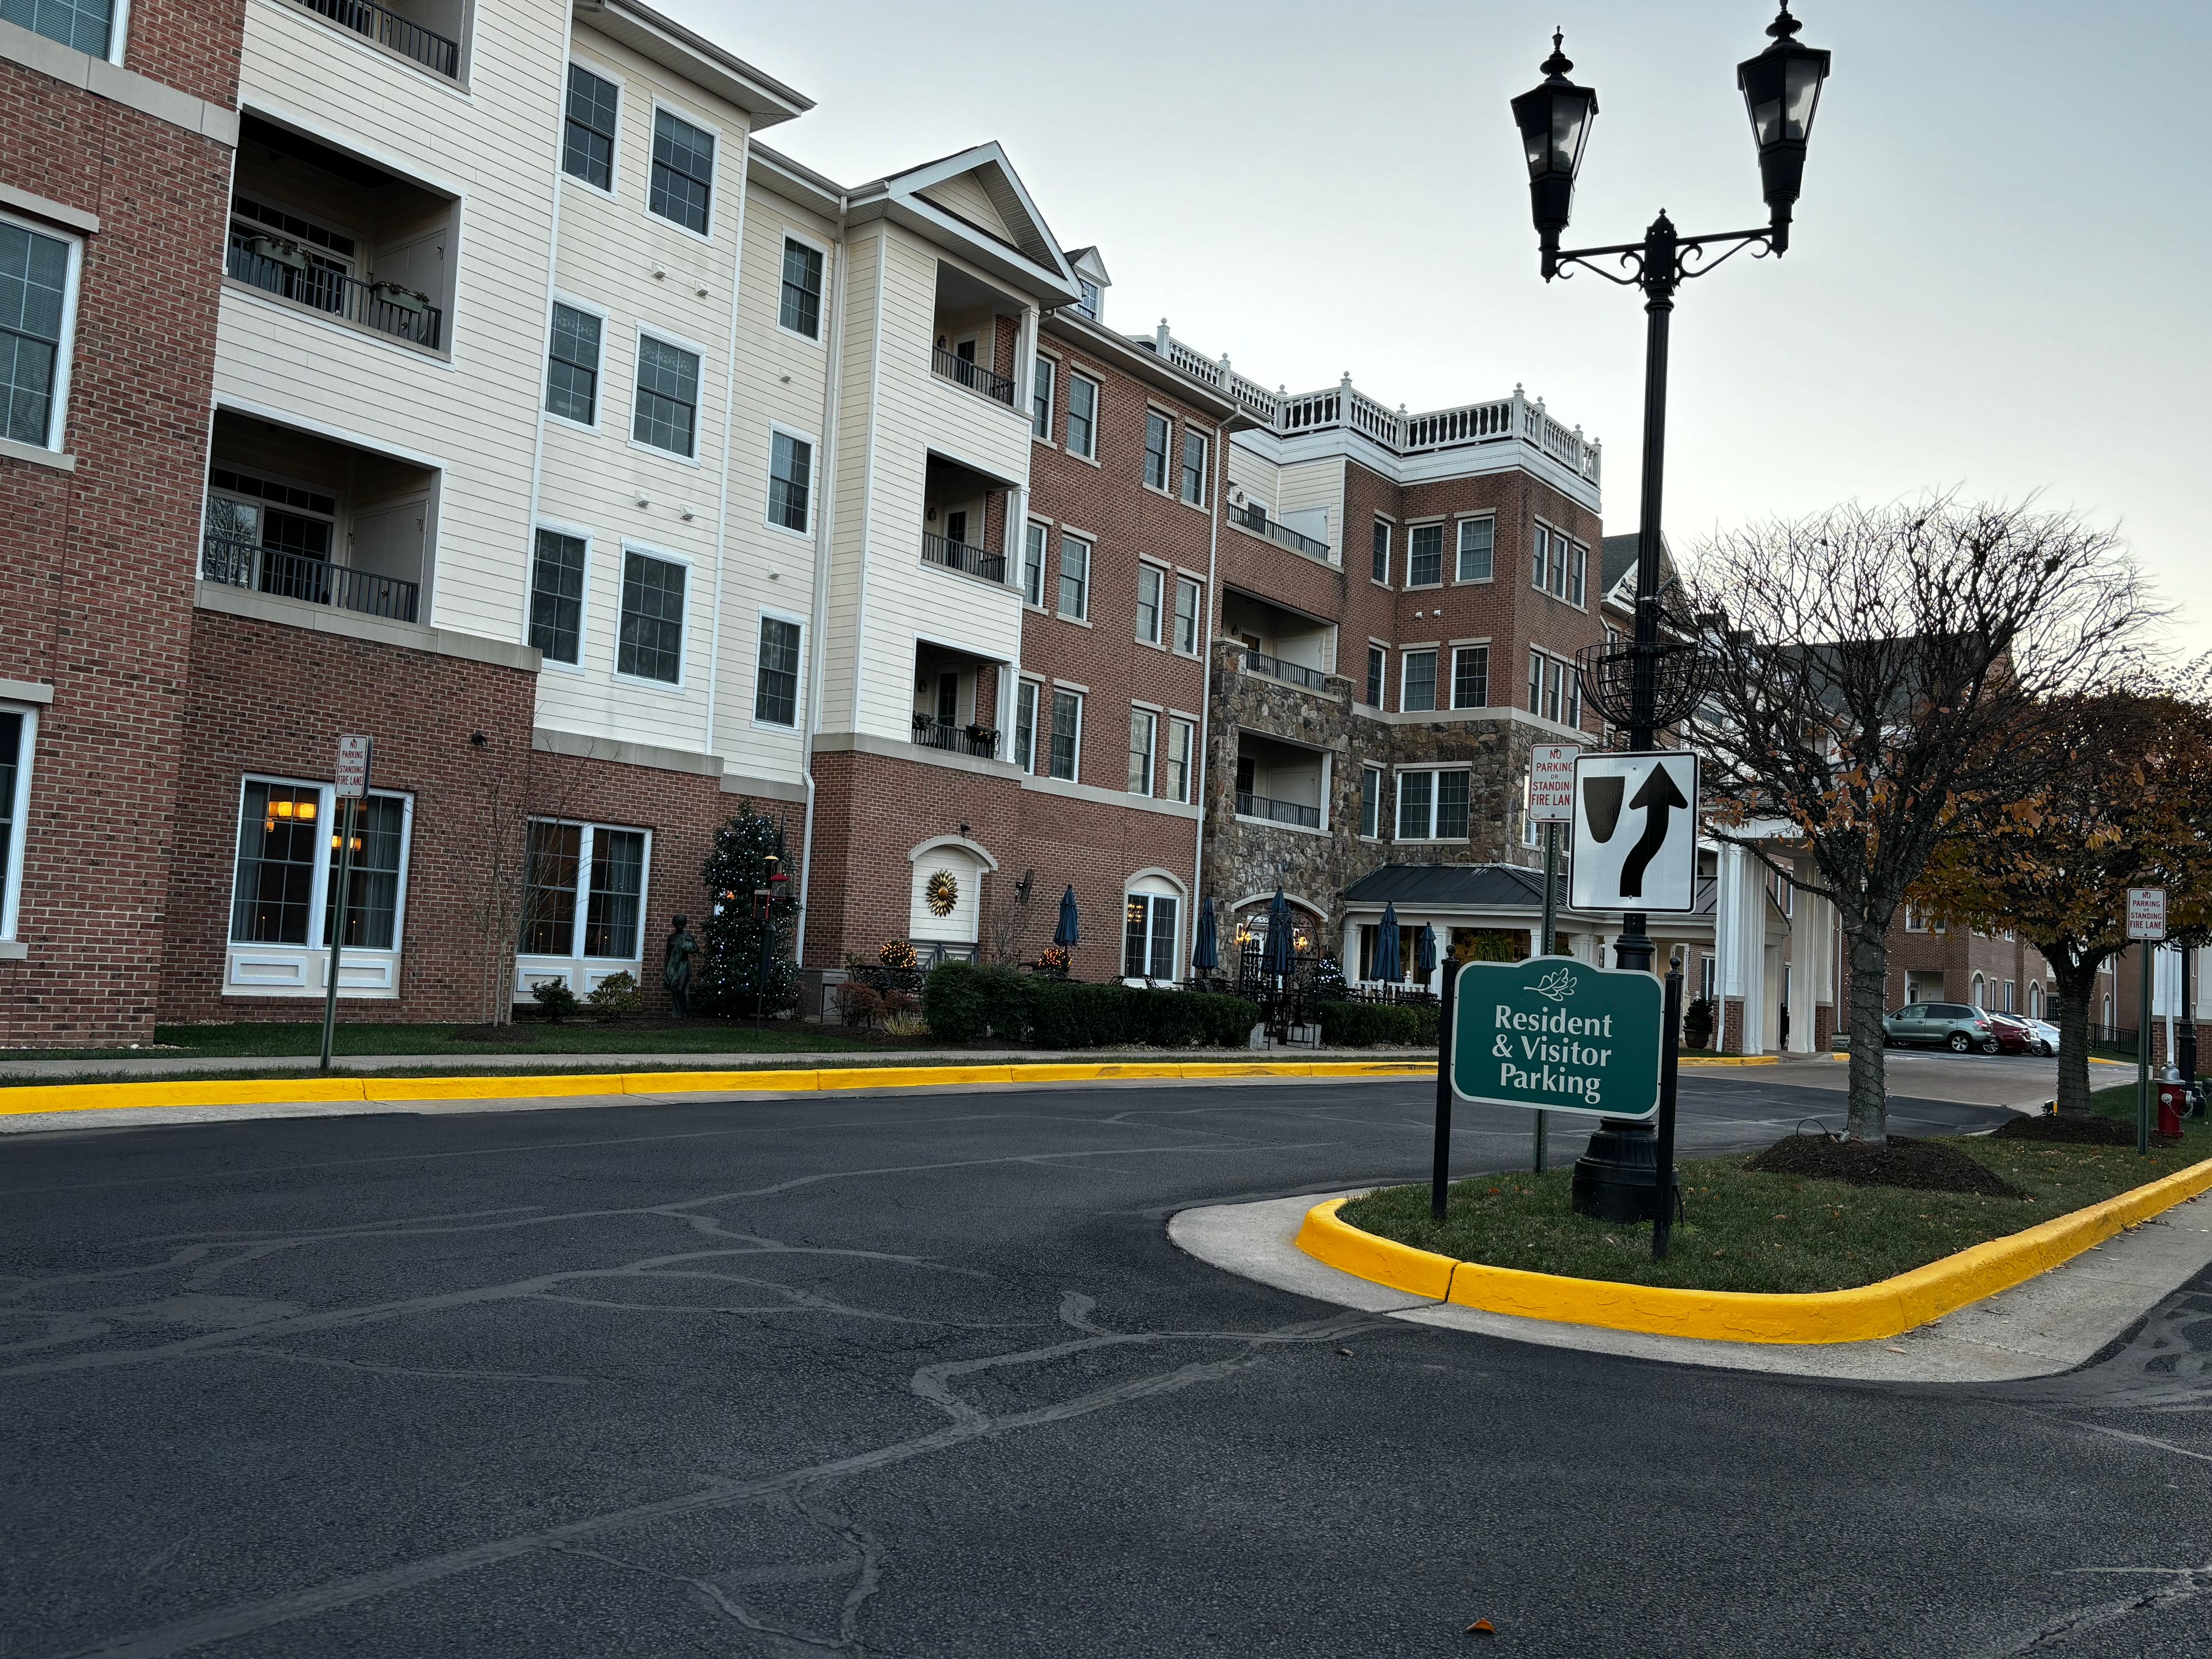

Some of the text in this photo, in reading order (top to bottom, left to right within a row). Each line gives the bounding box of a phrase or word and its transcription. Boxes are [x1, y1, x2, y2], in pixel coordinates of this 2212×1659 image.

[342, 751, 363, 759] PARKING
[1550, 750, 1562, 759] NO
[339, 766, 363, 774] STANDING
[338, 776, 362, 786] FIRE LANE
[1533, 782, 1572, 791] STANDIN
[1532, 794, 1571, 806] FIRE LAN
[2130, 921, 2162, 929] FIRE LANE
[1495, 1005, 1612, 1038] Resident
[1491, 1033, 1612, 1067] & Visitor
[1500, 1063, 1601, 1105] Parking
